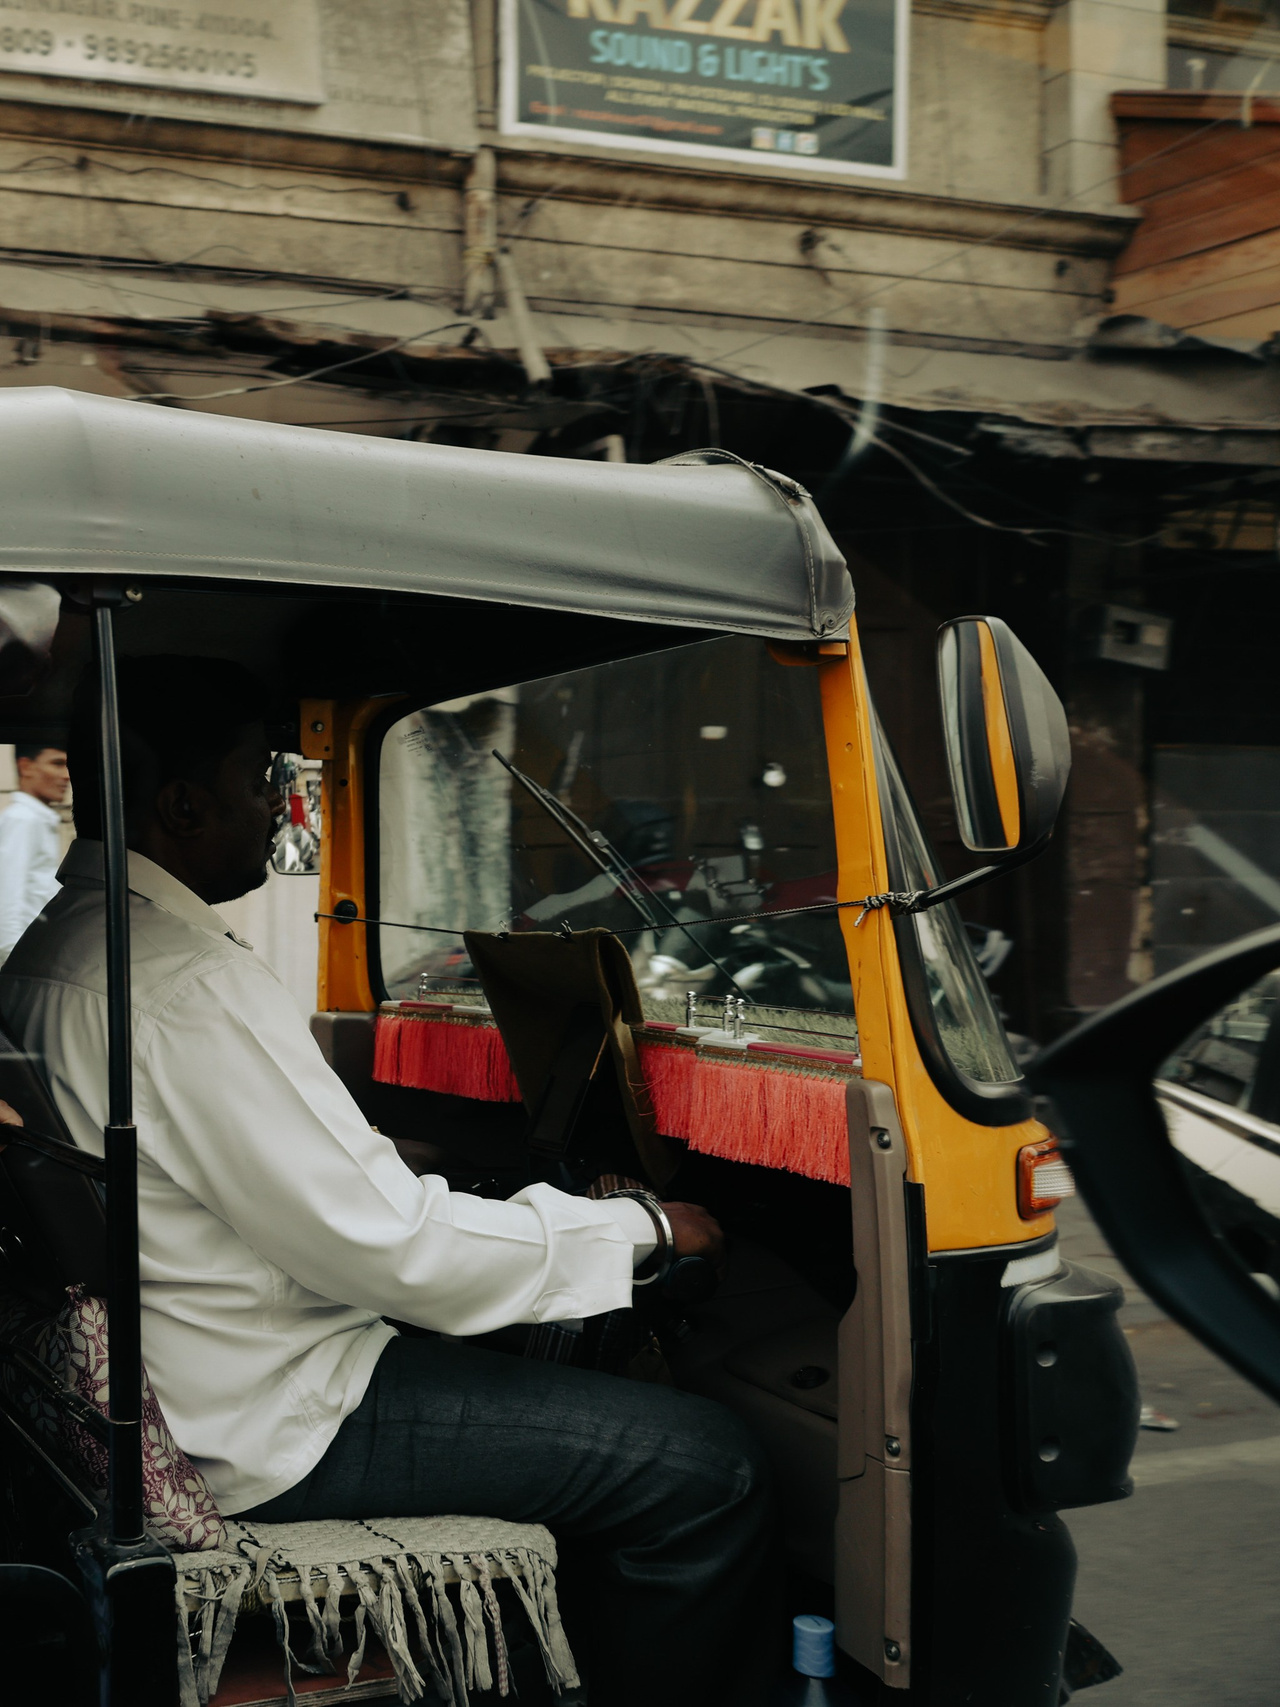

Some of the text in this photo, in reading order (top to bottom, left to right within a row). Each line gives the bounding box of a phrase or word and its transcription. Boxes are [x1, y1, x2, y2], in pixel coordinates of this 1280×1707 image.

[588, 29, 831, 92] SOUND & LIGHT'S
